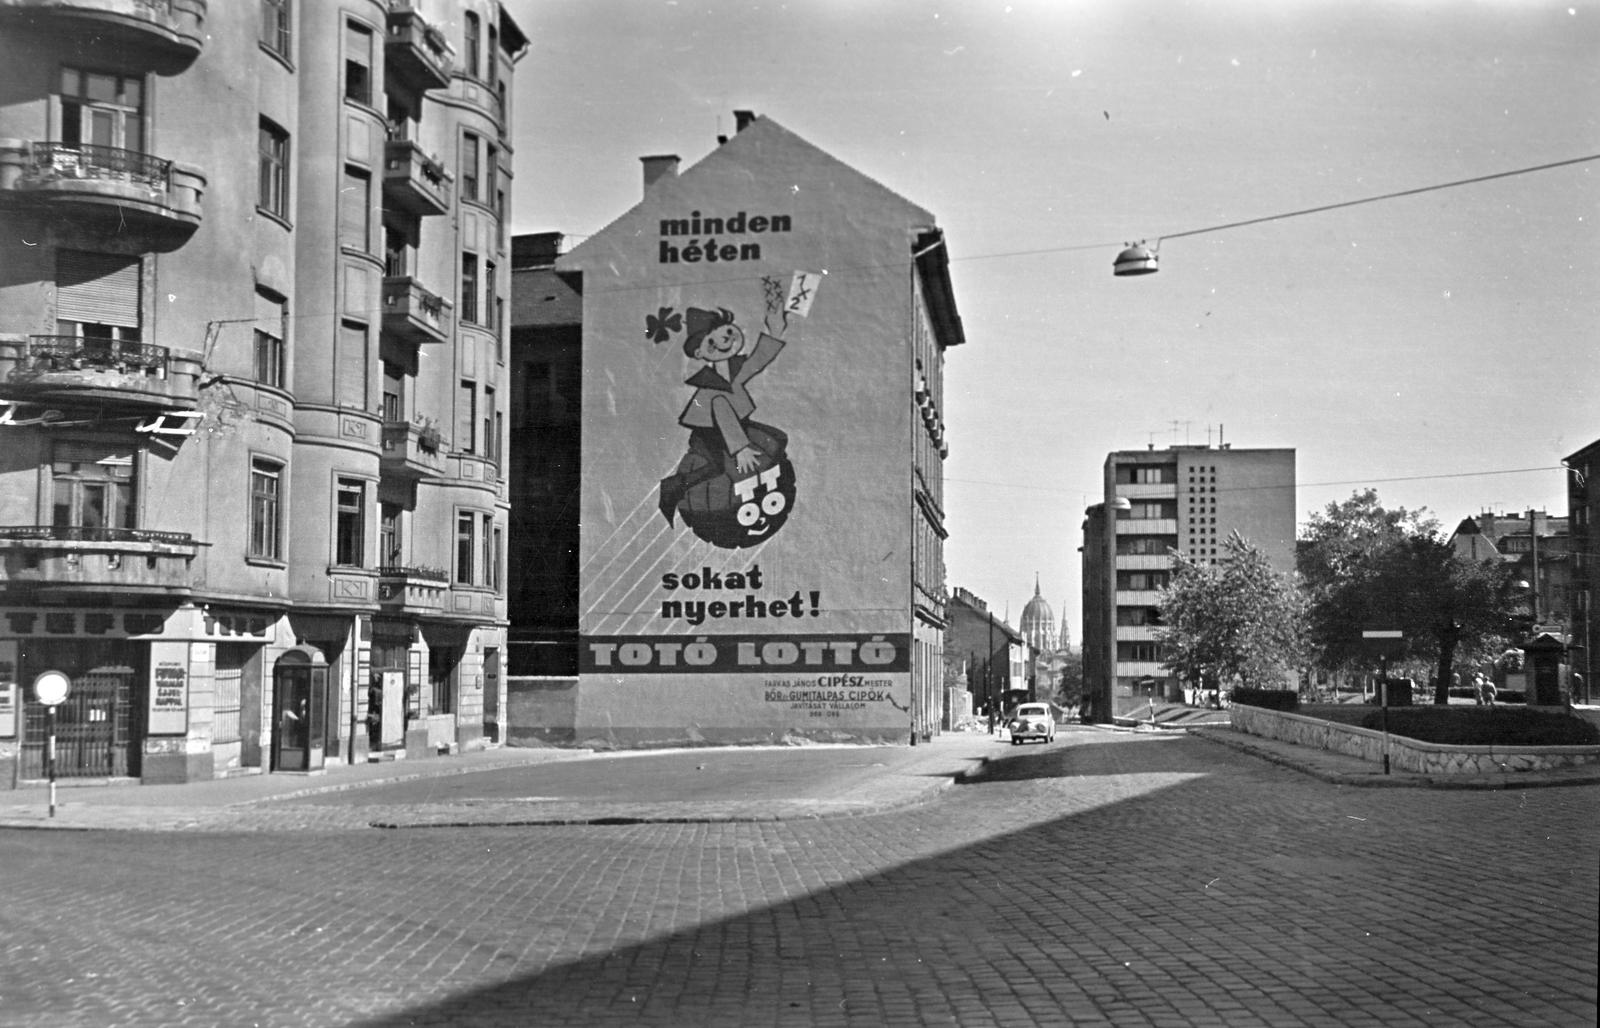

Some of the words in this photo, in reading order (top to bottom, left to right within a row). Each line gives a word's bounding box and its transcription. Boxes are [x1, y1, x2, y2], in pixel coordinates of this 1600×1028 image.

[660, 211, 791, 235] minden
[660, 239, 760, 263] héten
[790, 296, 800, 310] 2
[662, 565, 762, 590] sokat
[662, 591, 820, 625] nyerhet!
[589, 637, 717, 666] TOTÓ
[737, 635, 896, 666] LOTTÓ
